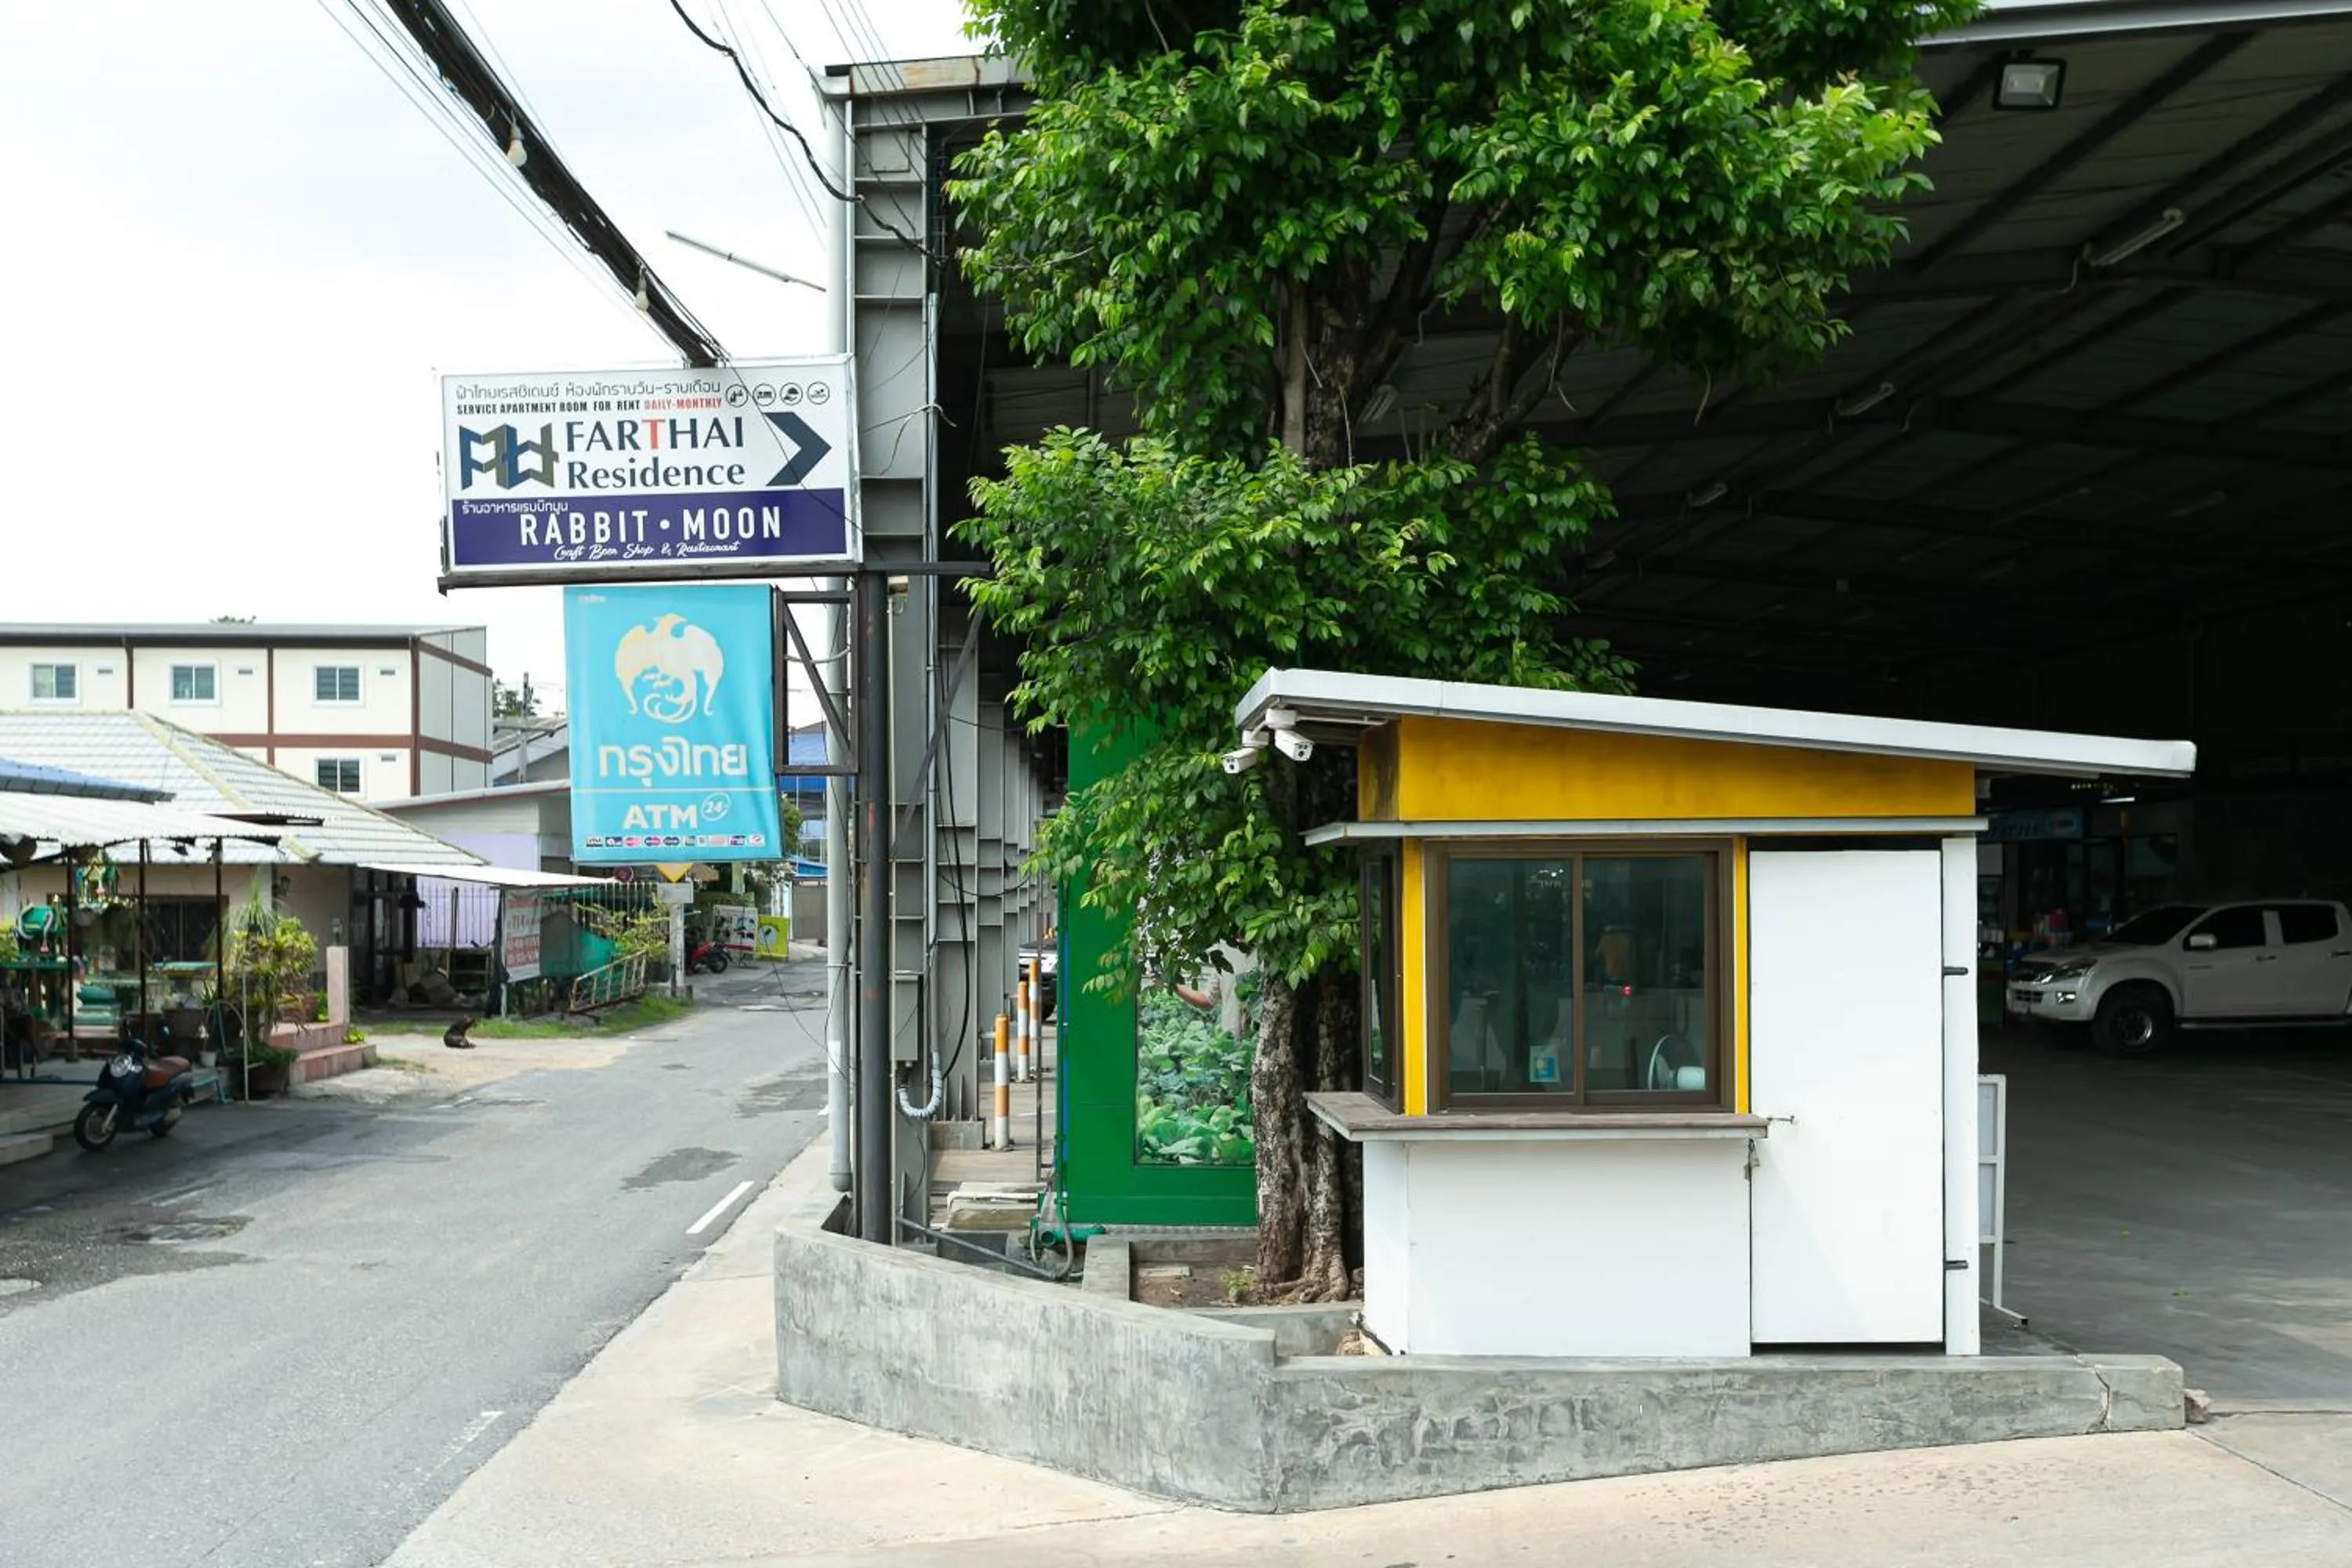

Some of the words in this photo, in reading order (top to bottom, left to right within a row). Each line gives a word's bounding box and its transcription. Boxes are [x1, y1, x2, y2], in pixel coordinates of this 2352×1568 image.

[457, 403, 497, 415] SERVICE
[499, 402, 556, 414] APARTMENT
[559, 401, 587, 412] ROOM
[593, 401, 612, 412] FOR
[617, 399, 641, 411] RENT
[565, 416, 744, 452] FARTHAI
[567, 456, 746, 490] Residence
[520, 510, 648, 546] RABBIT
[682, 506, 782, 541] MOON
[554, 544, 585, 560] Craft
[622, 543, 655, 559] Shop
[660, 542, 672, 557] &
[676, 539, 741, 557] Restaurant
[598, 736, 749, 788] กรุงไทย
[622, 804, 698, 829] ATM
